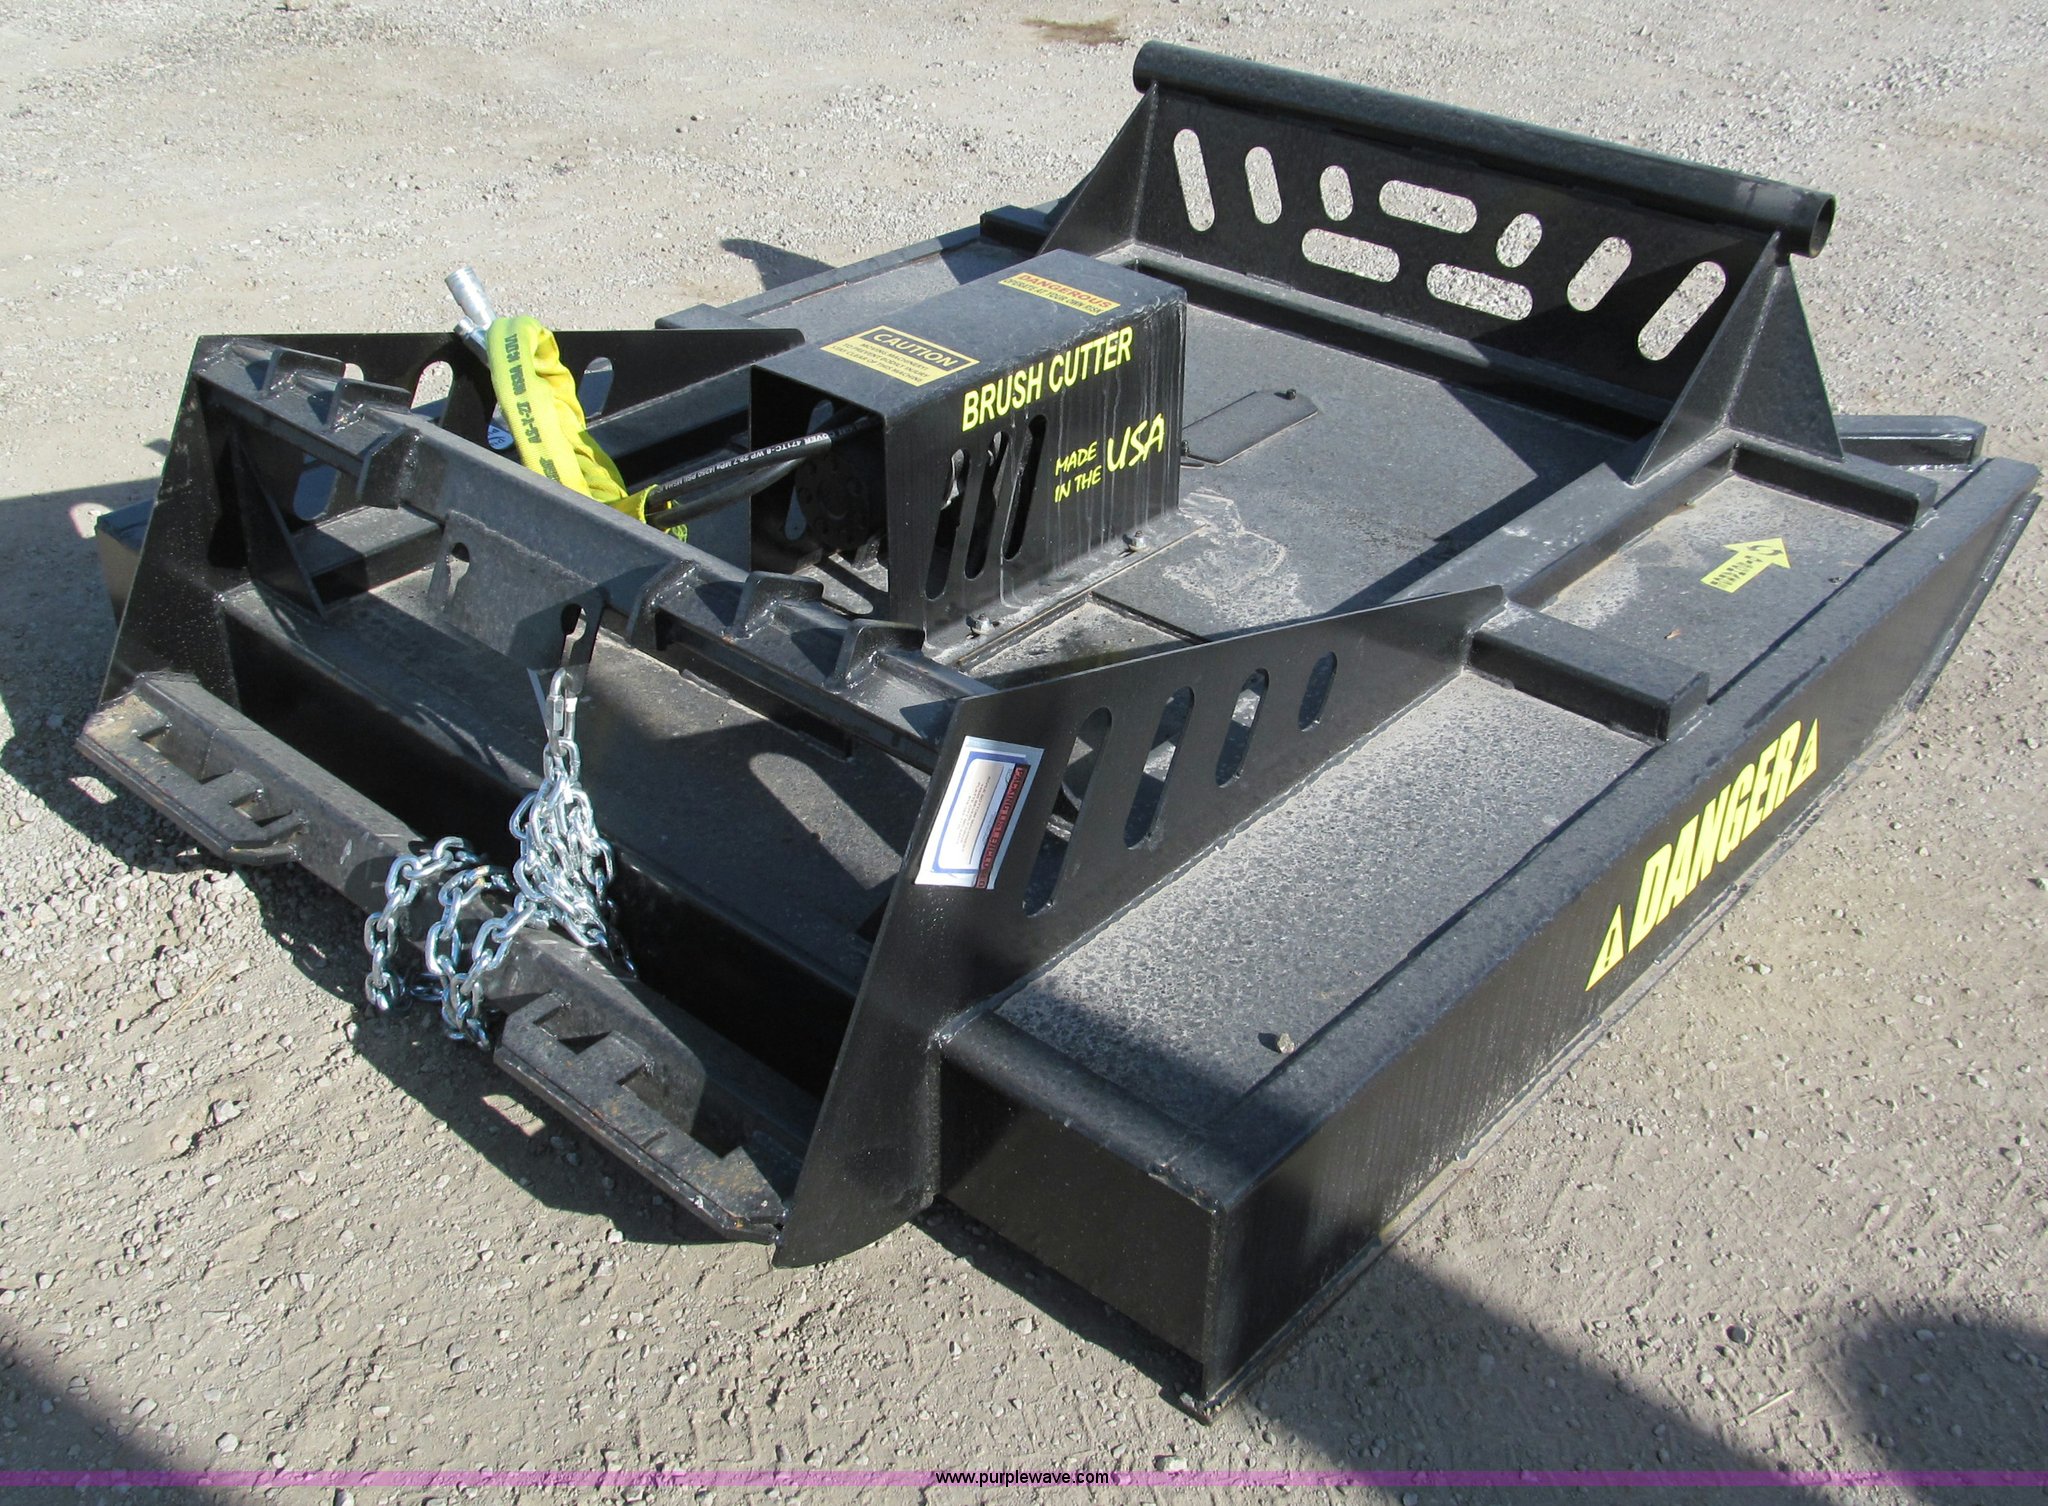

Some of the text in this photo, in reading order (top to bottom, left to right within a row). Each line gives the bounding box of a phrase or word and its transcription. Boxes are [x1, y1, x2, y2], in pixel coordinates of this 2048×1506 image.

[1018, 274, 1112, 307] DANGEROUS
[873, 333, 959, 367] CAUTION
[962, 326, 1134, 432] BRUSH CUTTER
[750, 450, 765, 460] WP
[766, 439, 802, 455] 471TC-8
[1055, 440, 1098, 476] MADE
[1107, 412, 1166, 473] USA
[1054, 465, 1102, 503] IN THE
[1628, 720, 1802, 953] DANGER
